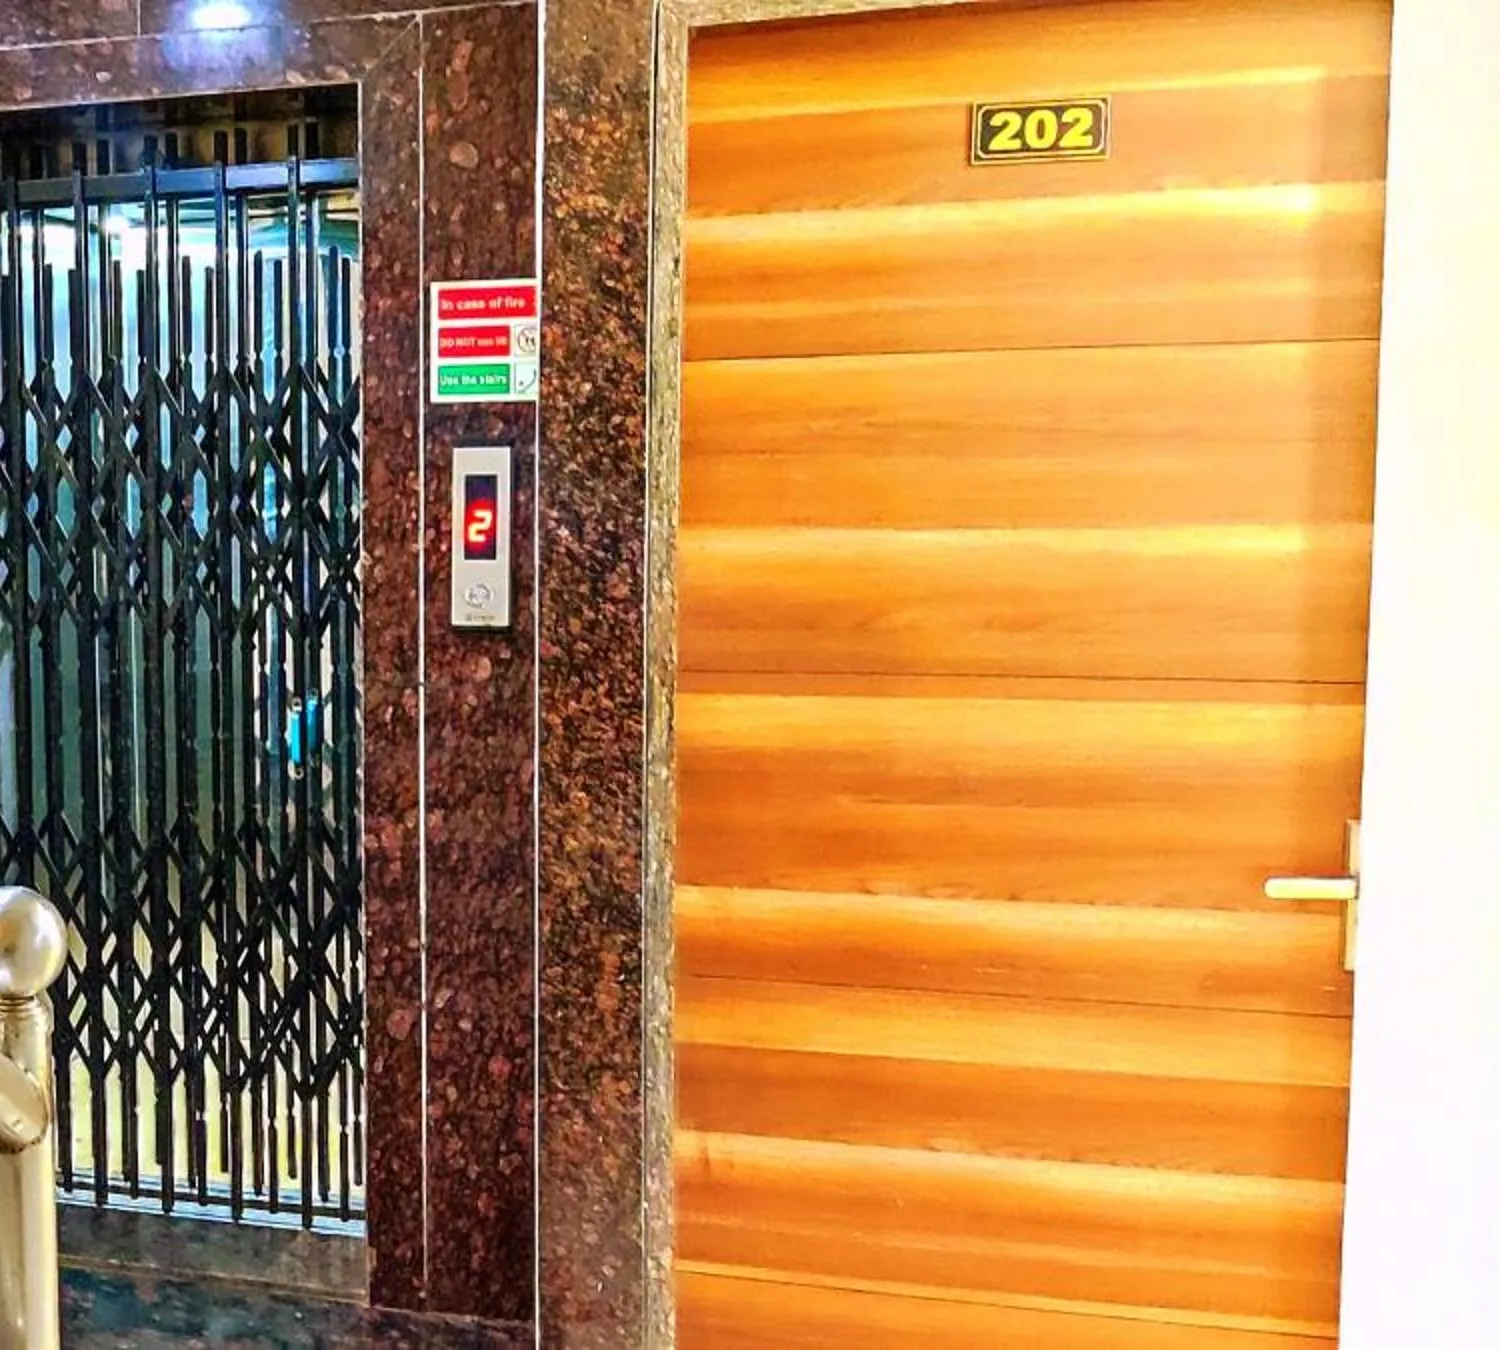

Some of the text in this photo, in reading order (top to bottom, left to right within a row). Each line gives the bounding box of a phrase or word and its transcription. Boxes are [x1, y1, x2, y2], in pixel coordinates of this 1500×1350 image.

[988, 107, 1093, 150] 202
[456, 299, 486, 311] case
[488, 296, 502, 309] of
[504, 296, 526, 309] fire
[468, 509, 492, 542] 2
